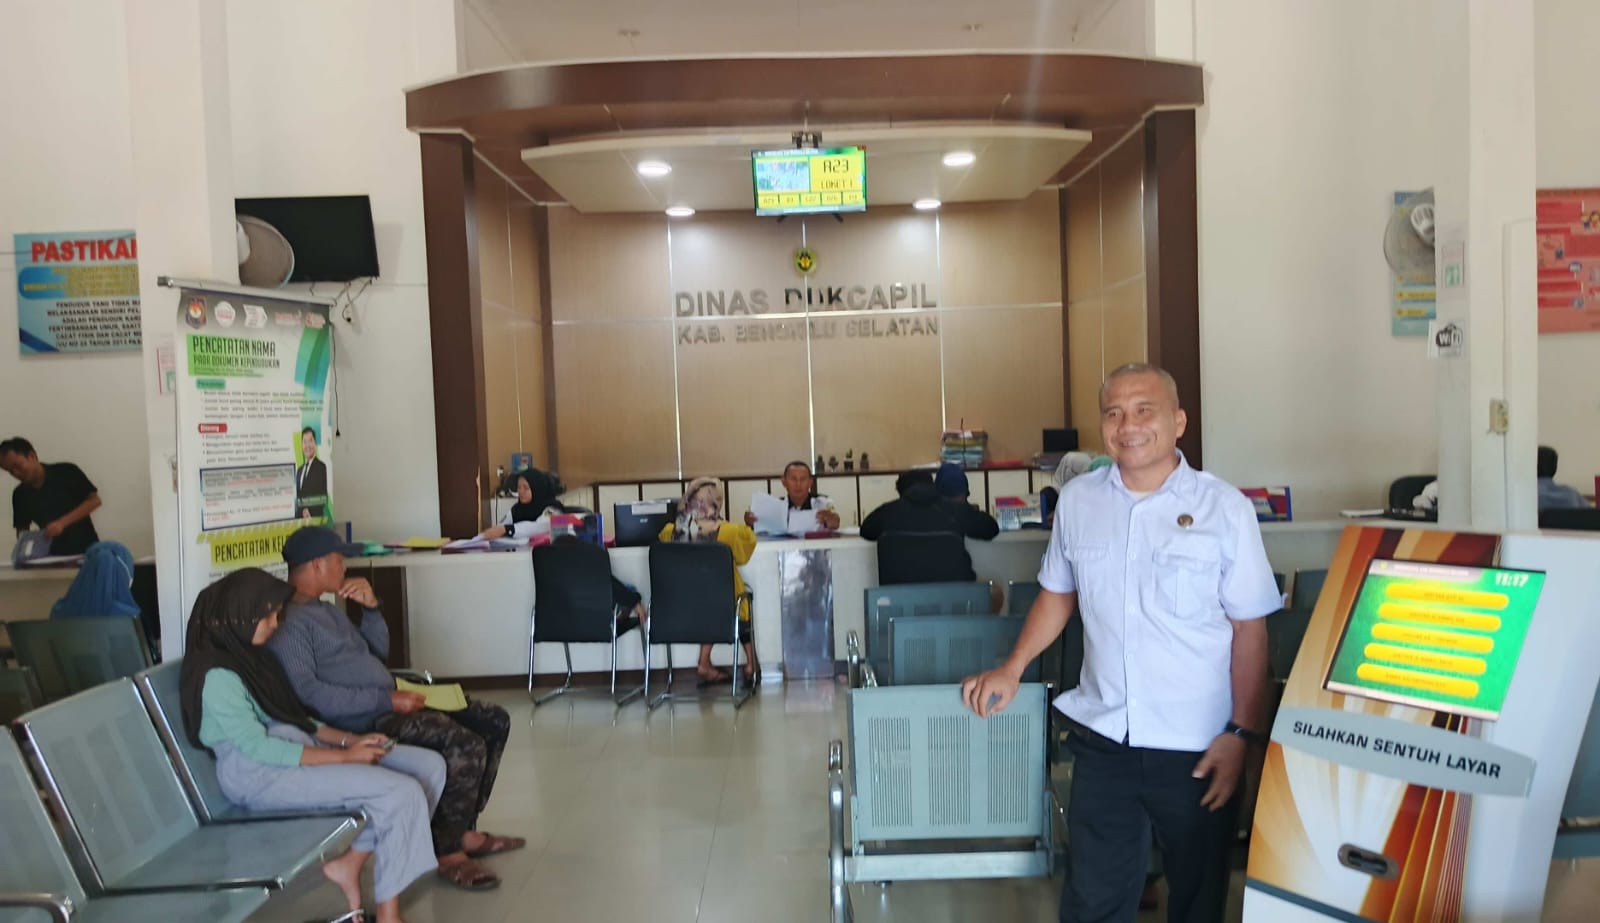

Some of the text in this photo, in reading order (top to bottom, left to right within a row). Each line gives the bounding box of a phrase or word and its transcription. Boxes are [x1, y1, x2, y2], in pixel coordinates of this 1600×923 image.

[823, 159, 849, 173] A23
[676, 283, 937, 317] DINAS DUKCAPIL
[678, 324, 726, 345] KAB.
[846, 317, 938, 339] SELATAN
[192, 335, 276, 357] PENCATATAN NAMA
[215, 539, 270, 563] PENCATATAN
[1495, 572, 1529, 588] 11:17
[1293, 721, 1502, 778] SILAHKAN SENTUH LAYAR
